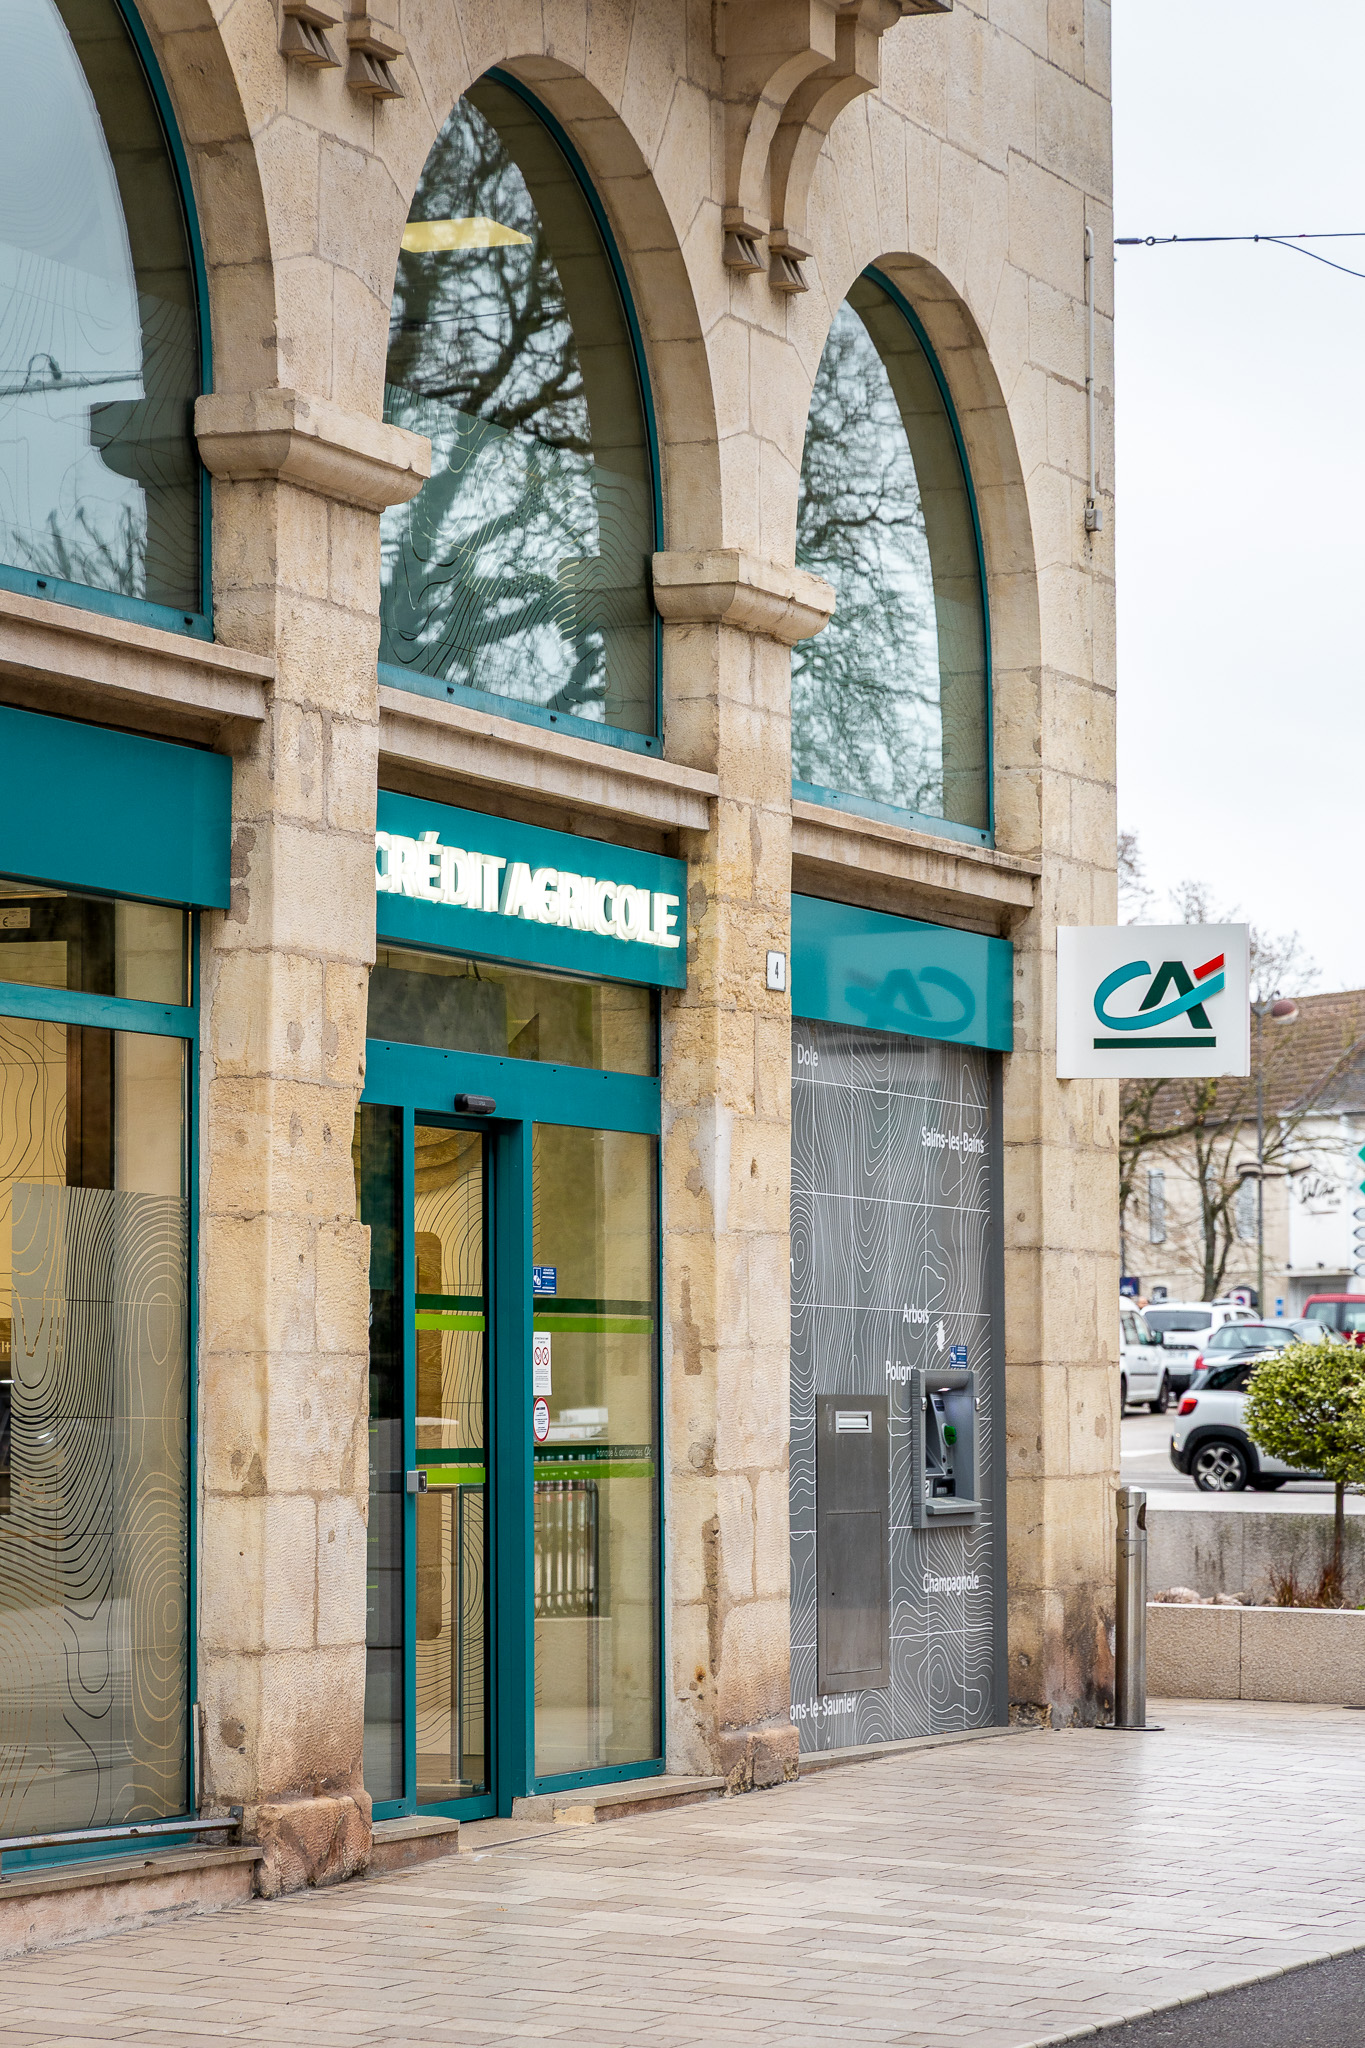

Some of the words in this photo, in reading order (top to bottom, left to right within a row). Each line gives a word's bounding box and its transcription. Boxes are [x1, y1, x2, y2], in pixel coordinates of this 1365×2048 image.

[375, 831, 507, 913] CRÉDIT
[499, 862, 680, 948] AGRICOLE
[797, 1043, 819, 1067] Dole
[921, 1126, 985, 1154] Salins-les-Bains
[902, 1303, 929, 1323] Arbois
[885, 1361, 915, 1386] Polign
[922, 1570, 980, 1597] Champagnole
[789, 1693, 856, 1720] ons-le-Saunier
